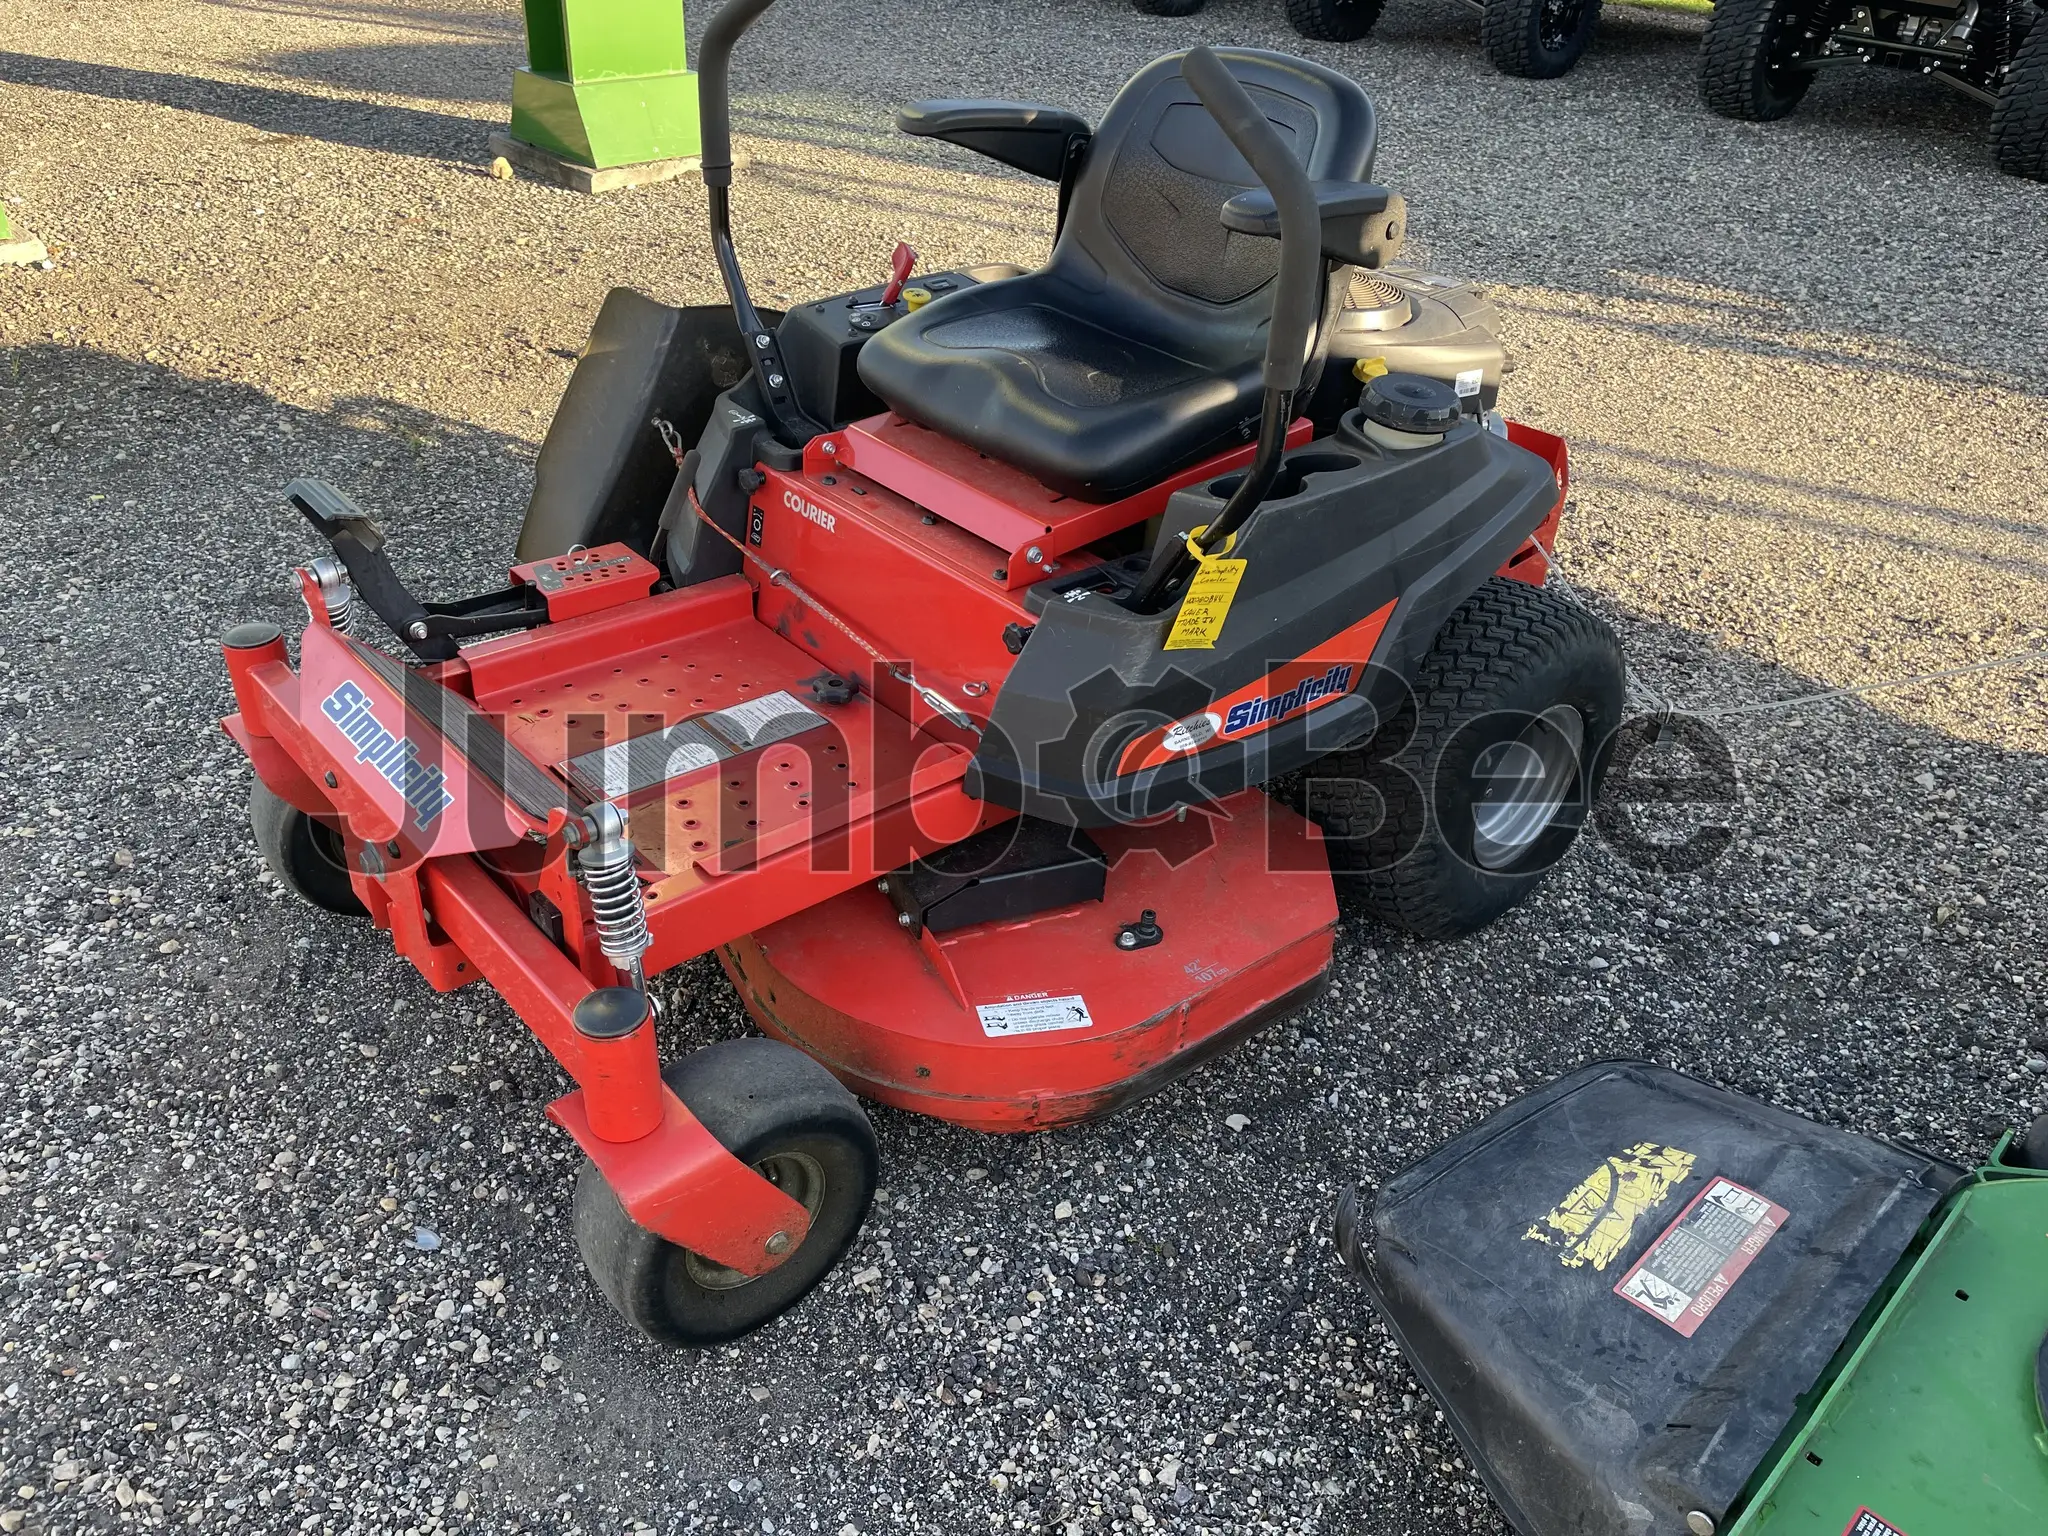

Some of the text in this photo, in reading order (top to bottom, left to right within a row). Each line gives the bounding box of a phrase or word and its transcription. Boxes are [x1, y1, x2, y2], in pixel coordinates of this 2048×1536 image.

[783, 490, 838, 534] COURIER
[1180, 627, 1207, 637] MARK
[1224, 664, 1353, 735] Simplicity
[1173, 719, 1211, 738] Ritchies
[320, 679, 455, 832] Simplicity
[1183, 958, 1202, 974] 42"
[1013, 992, 1049, 1001] DANGER
[1739, 1223, 1772, 1255] DANGER
[1690, 1281, 1725, 1317] PELIGRO
